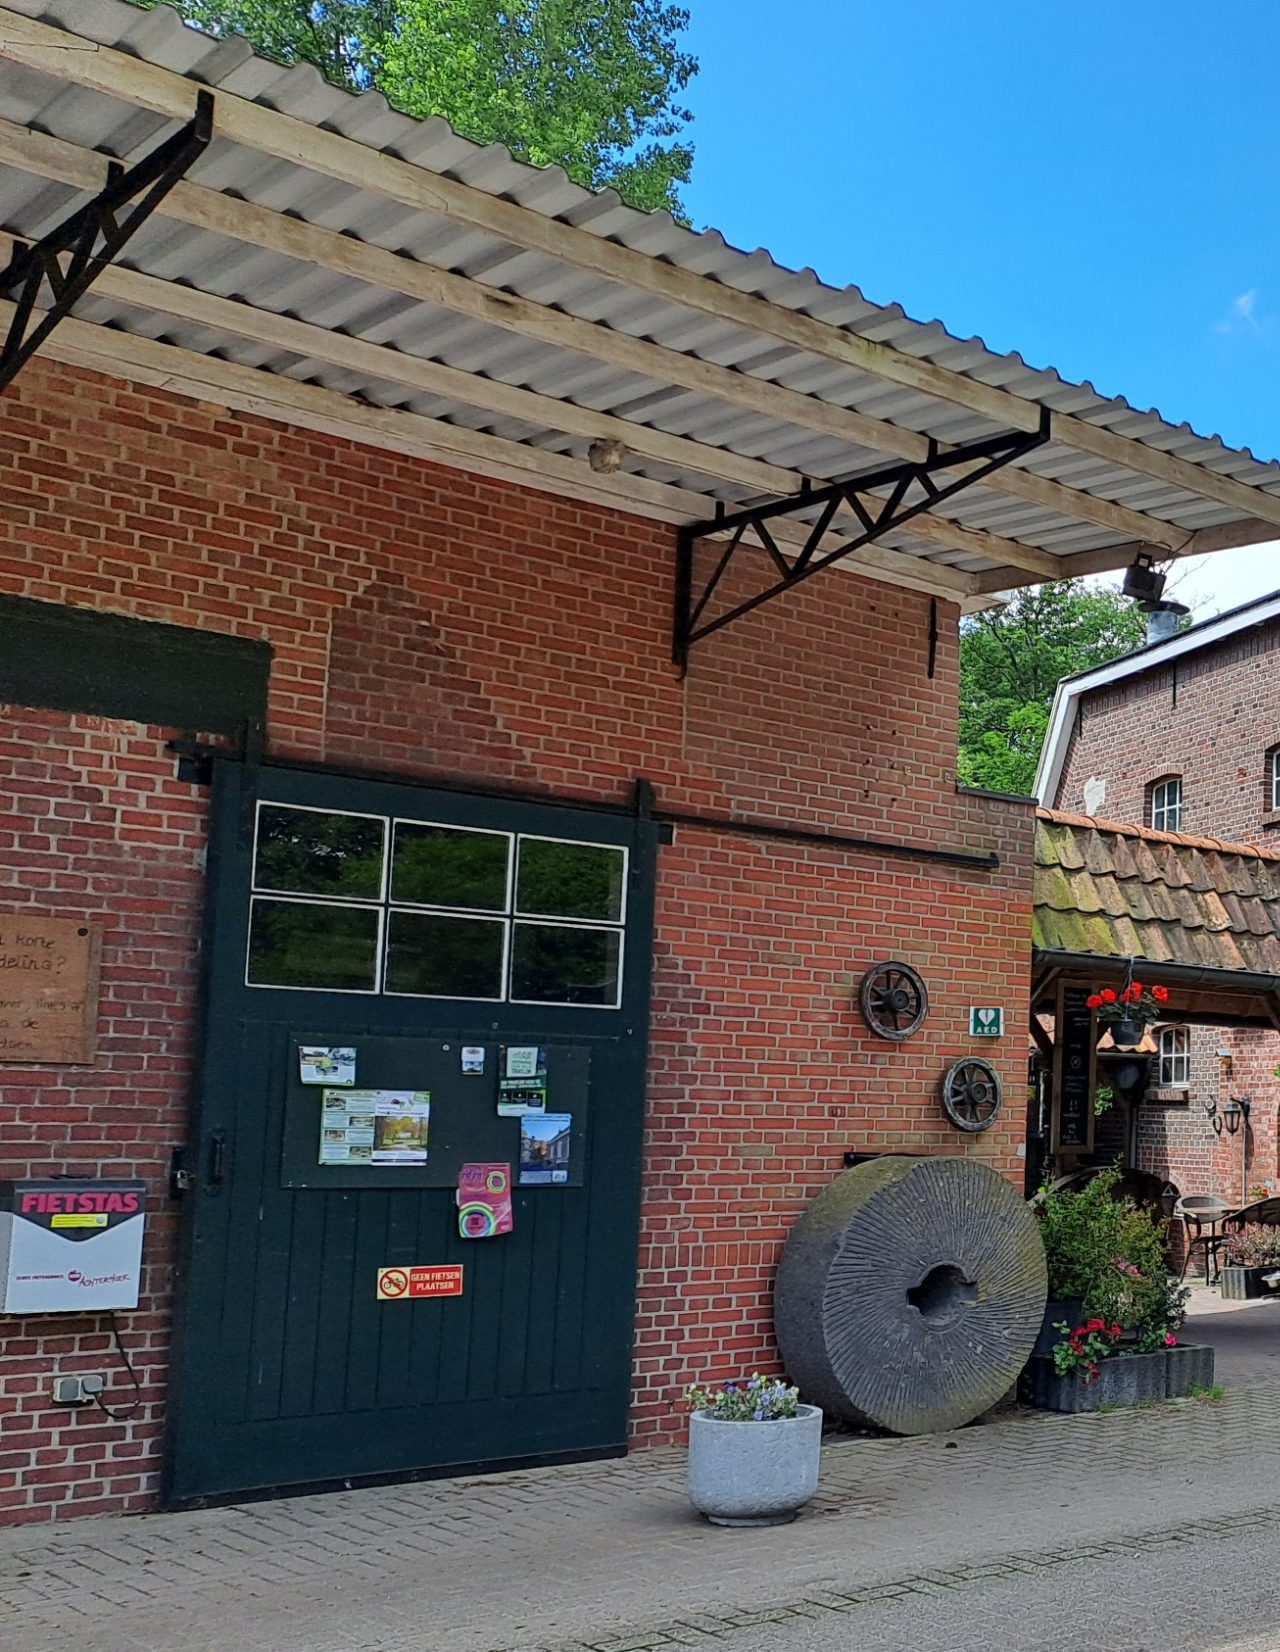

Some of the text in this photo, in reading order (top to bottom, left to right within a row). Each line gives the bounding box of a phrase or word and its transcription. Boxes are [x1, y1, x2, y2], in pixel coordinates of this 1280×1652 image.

[976, 1026, 998, 1034] AED
[22, 1193, 138, 1212] FIETSTAS
[411, 1271, 460, 1281] GEEN FIETSEN
[416, 1281, 455, 1291] PLAATSEN
